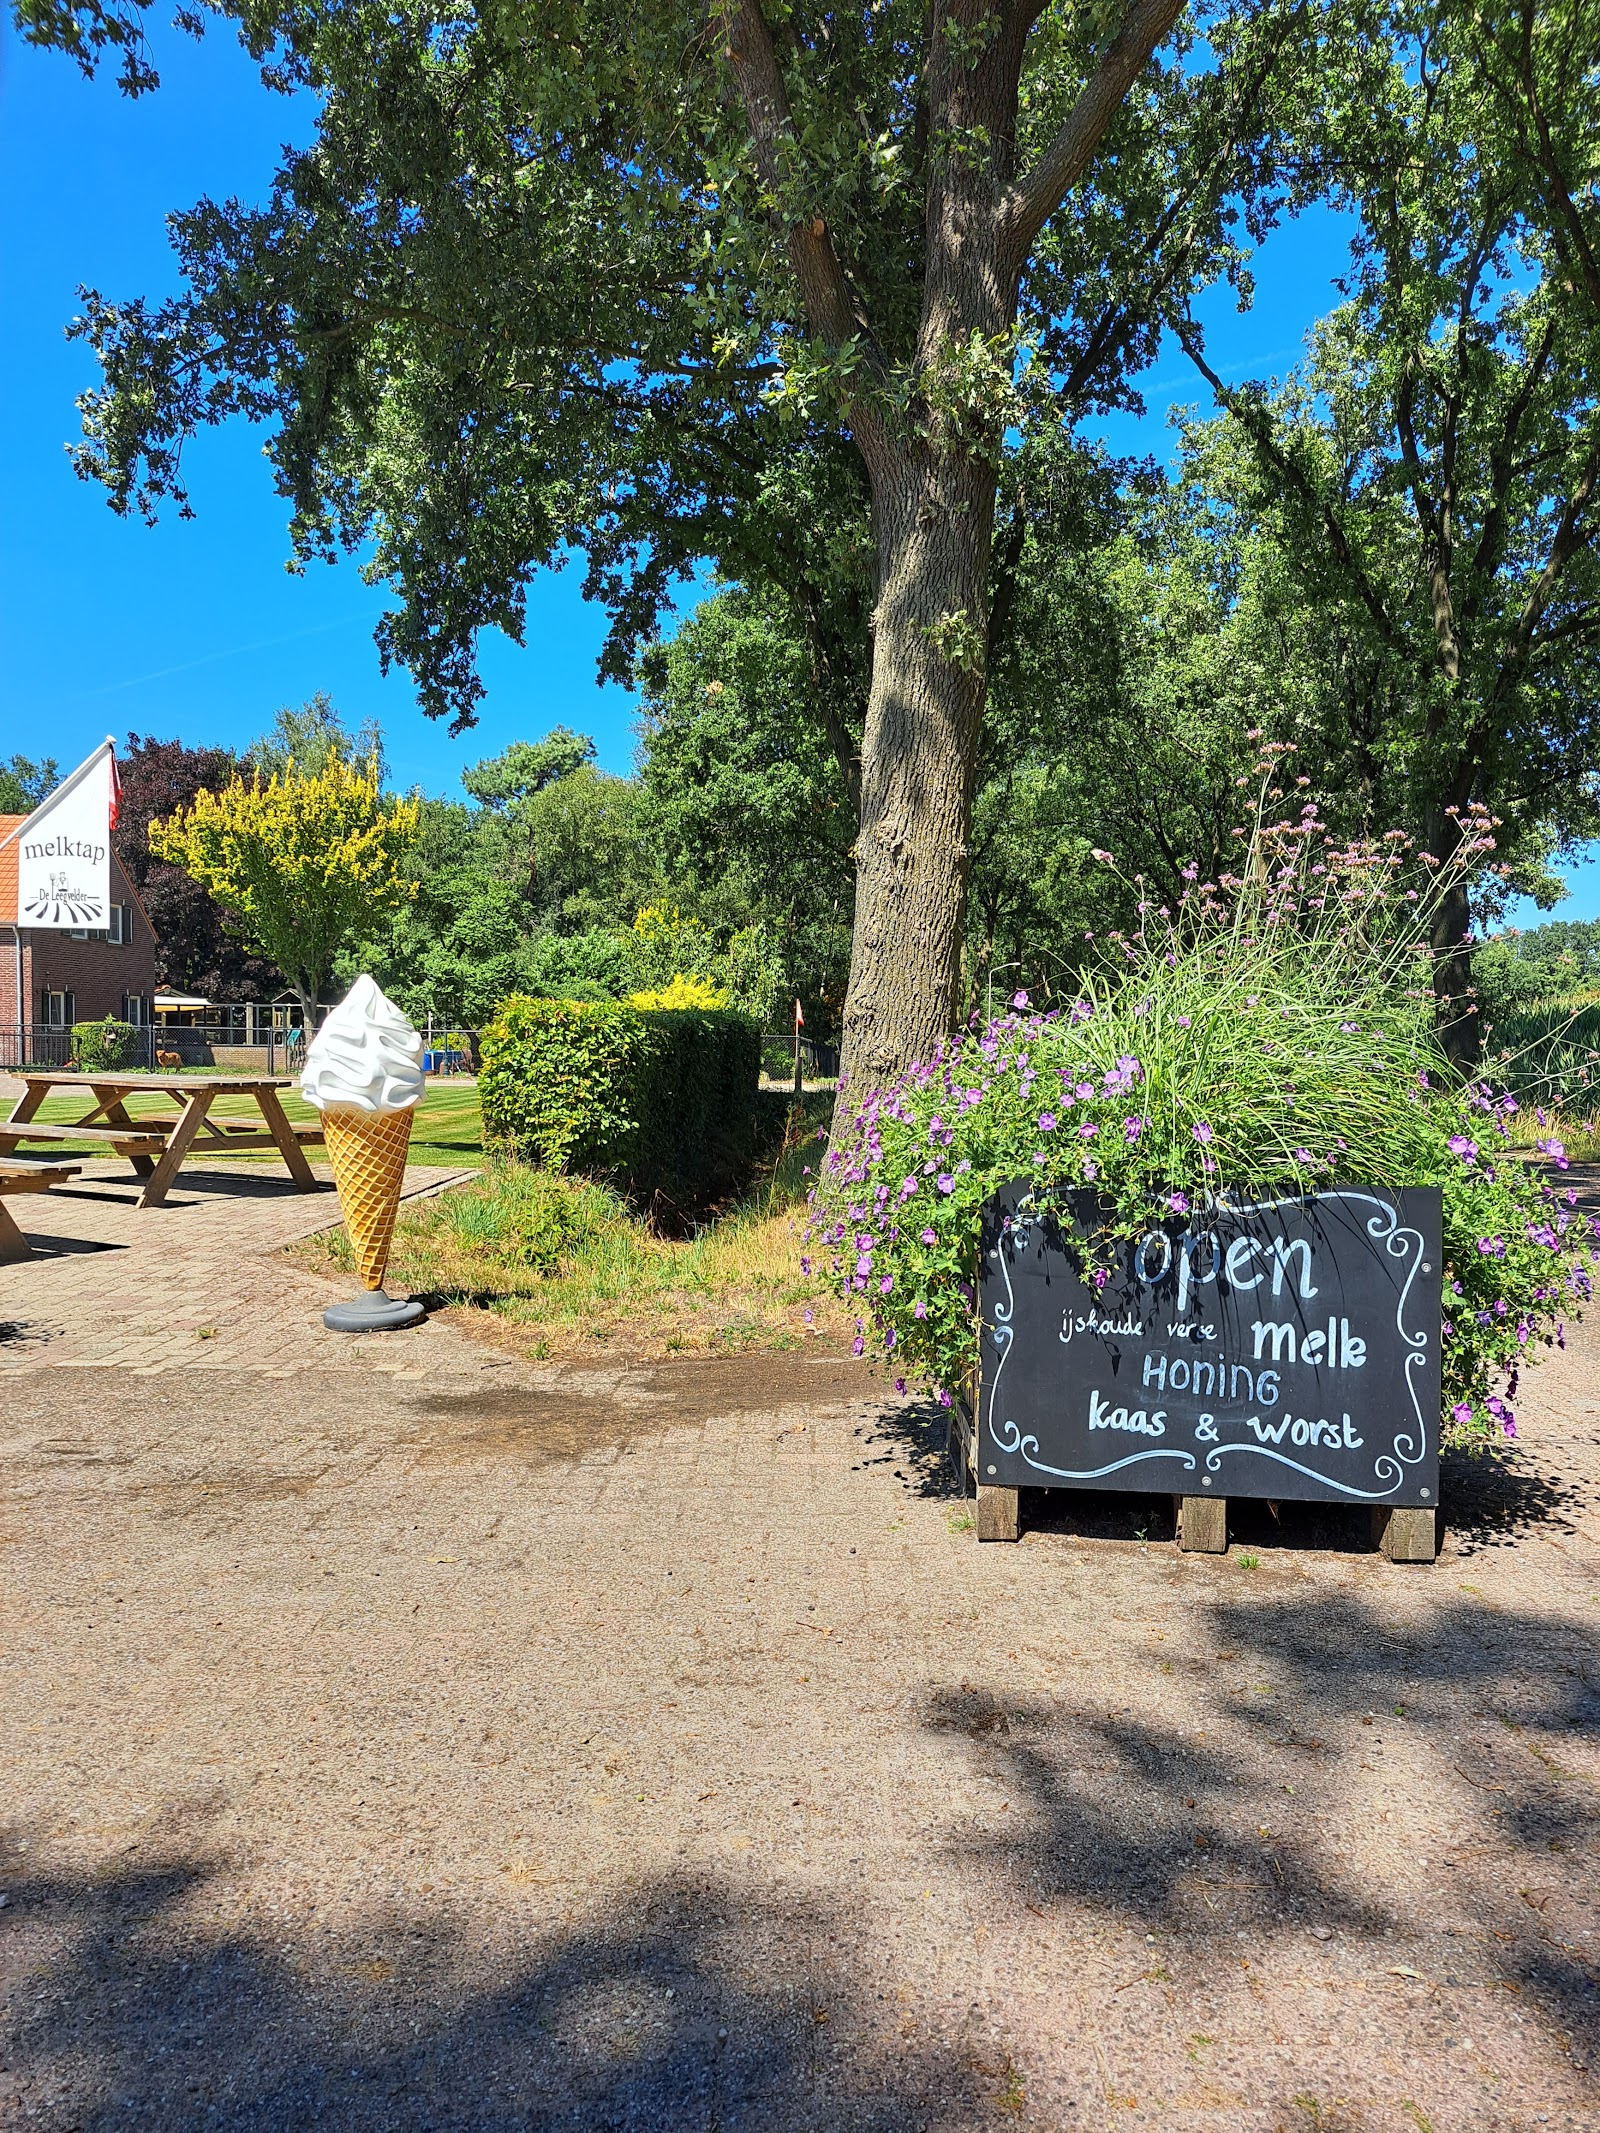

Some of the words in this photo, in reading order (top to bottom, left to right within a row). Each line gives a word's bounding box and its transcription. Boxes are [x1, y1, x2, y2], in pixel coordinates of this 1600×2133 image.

[25, 836, 105, 865] melktap
[39, 888, 50, 901] De
[1134, 1228, 1318, 1312] open
[1058, 1308, 1144, 1343] ijskoude
[1195, 1413, 1220, 1442] &
